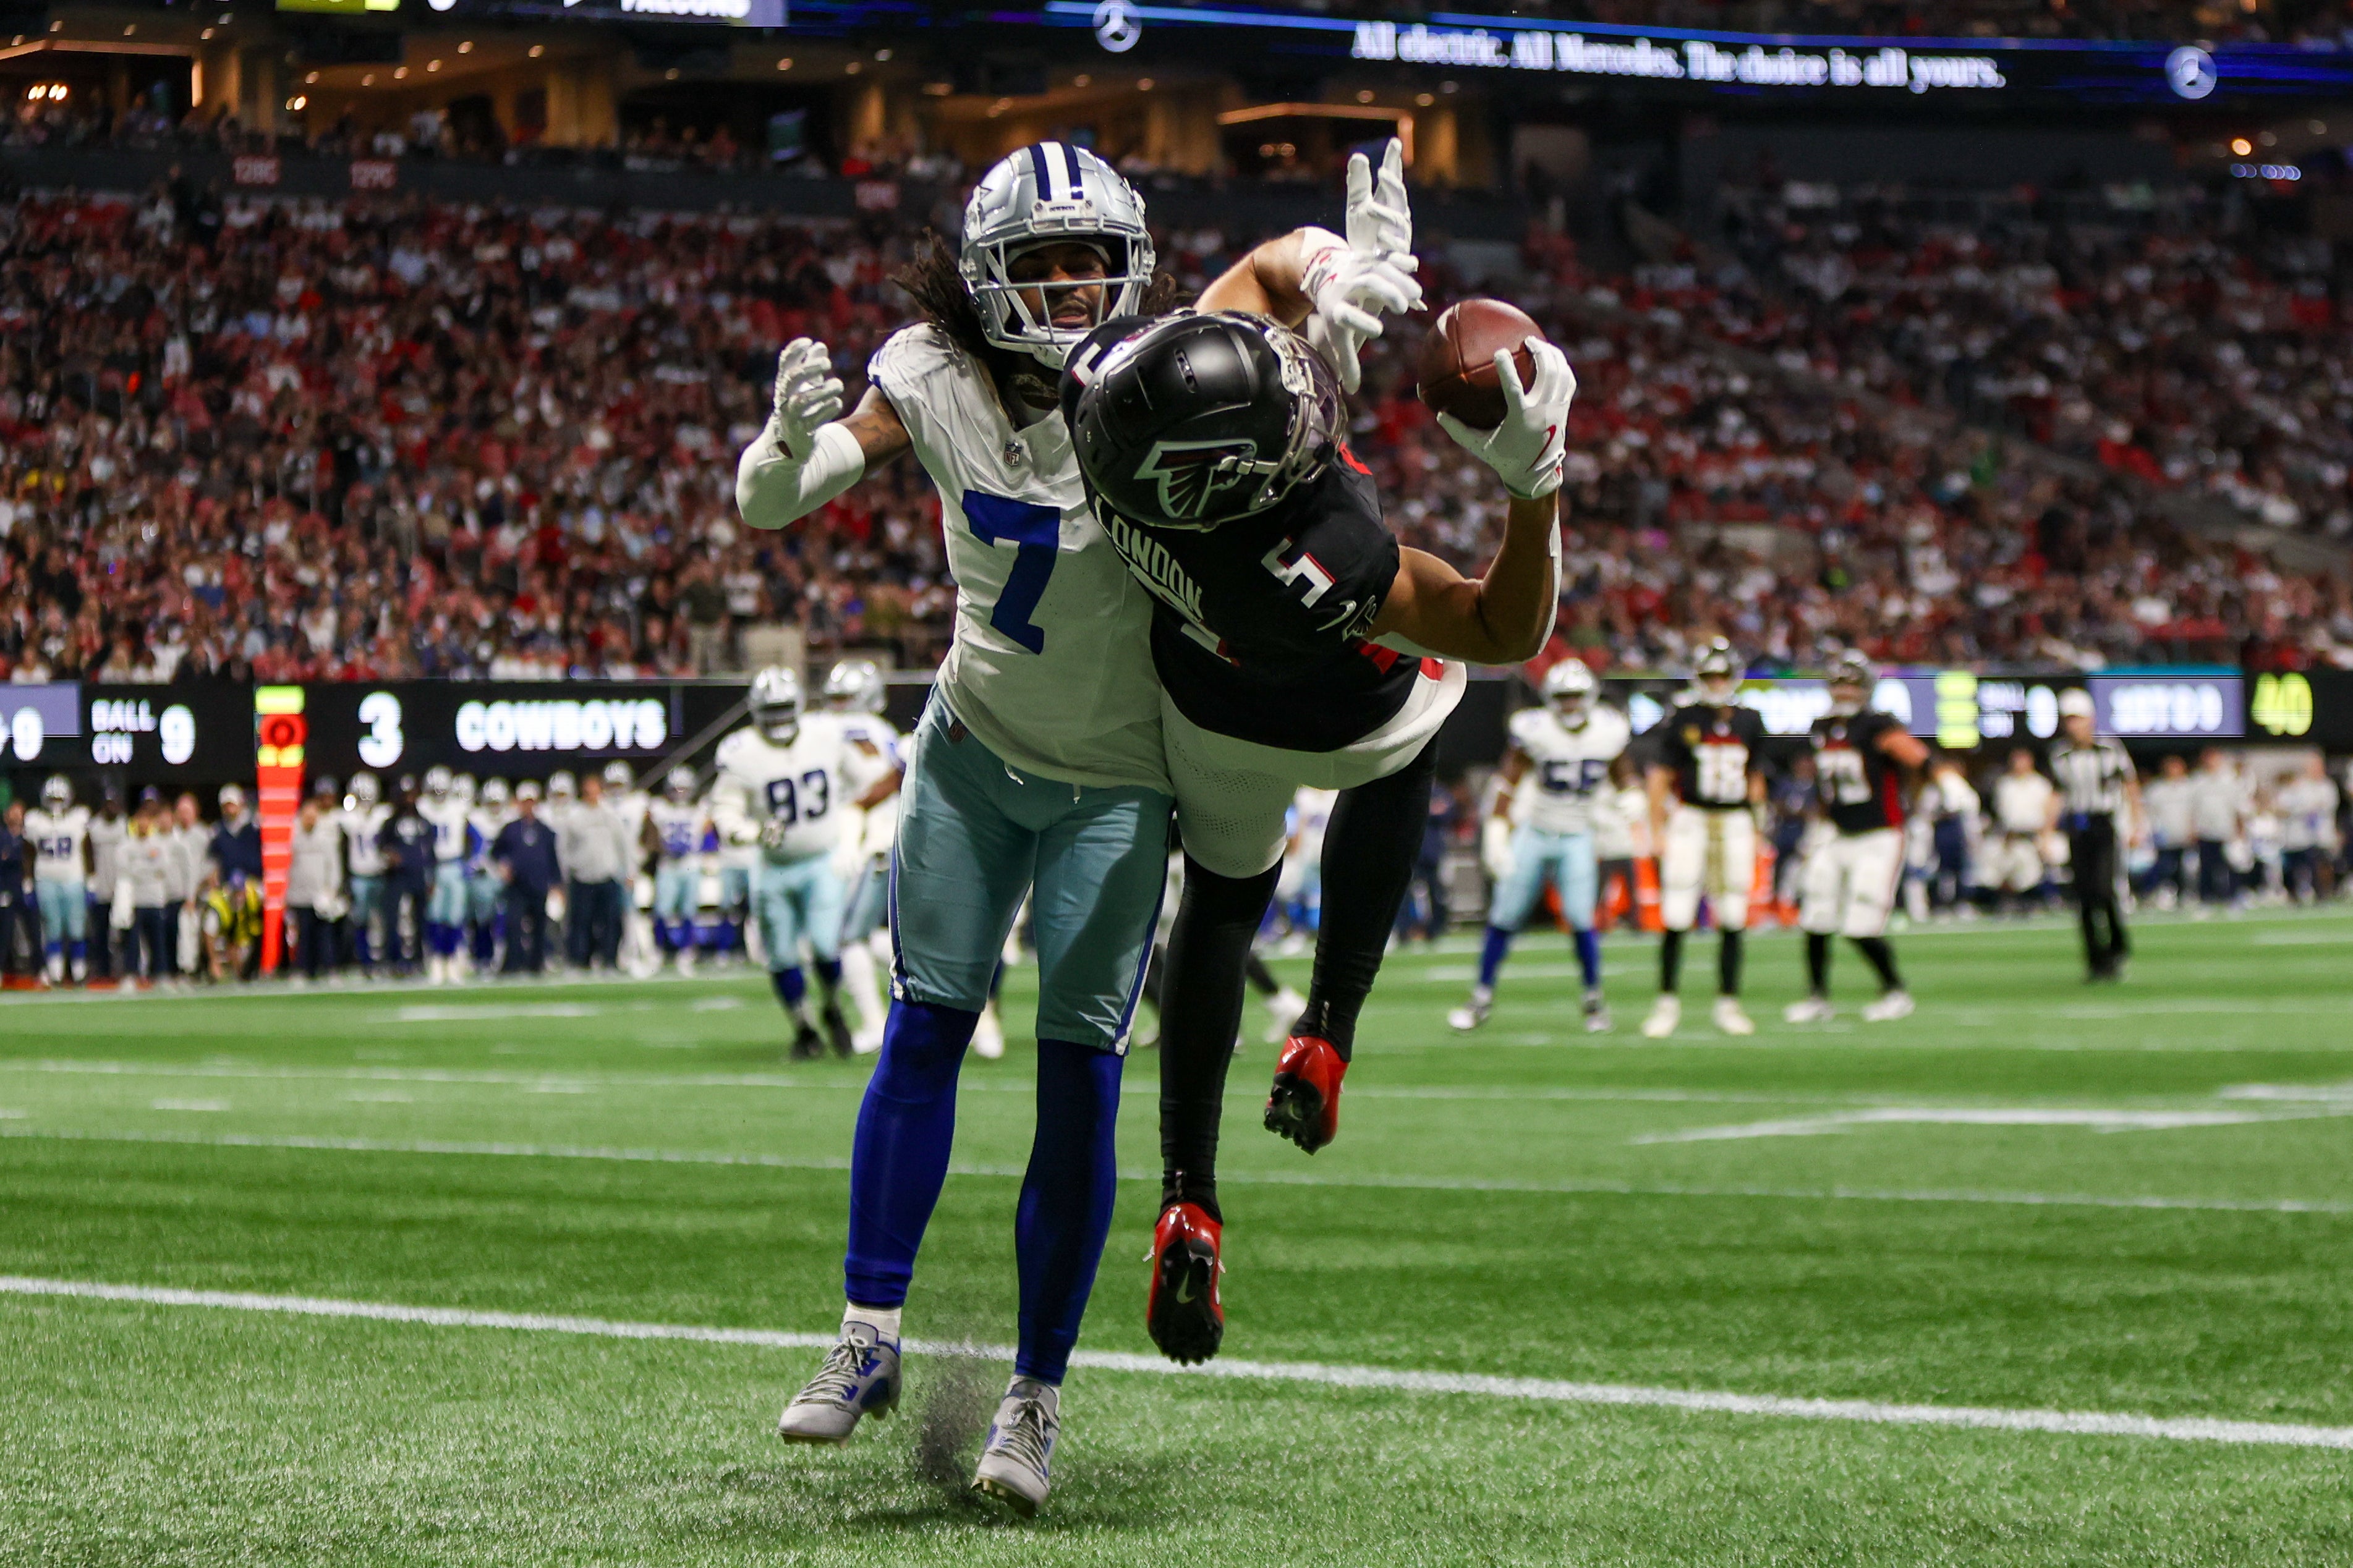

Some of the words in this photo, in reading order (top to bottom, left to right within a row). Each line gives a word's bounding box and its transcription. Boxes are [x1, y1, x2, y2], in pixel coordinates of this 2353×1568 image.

[1005, 453, 1019, 465] NFL
[962, 489, 1060, 655] 7
[1094, 494, 1204, 621] LONDON
[1261, 535, 1336, 609] 5
[91, 699, 156, 732] BALL
[160, 703, 196, 765] 9
[358, 691, 404, 768] 3
[456, 698, 666, 752] COWBOYS
[91, 732, 133, 764] ON
